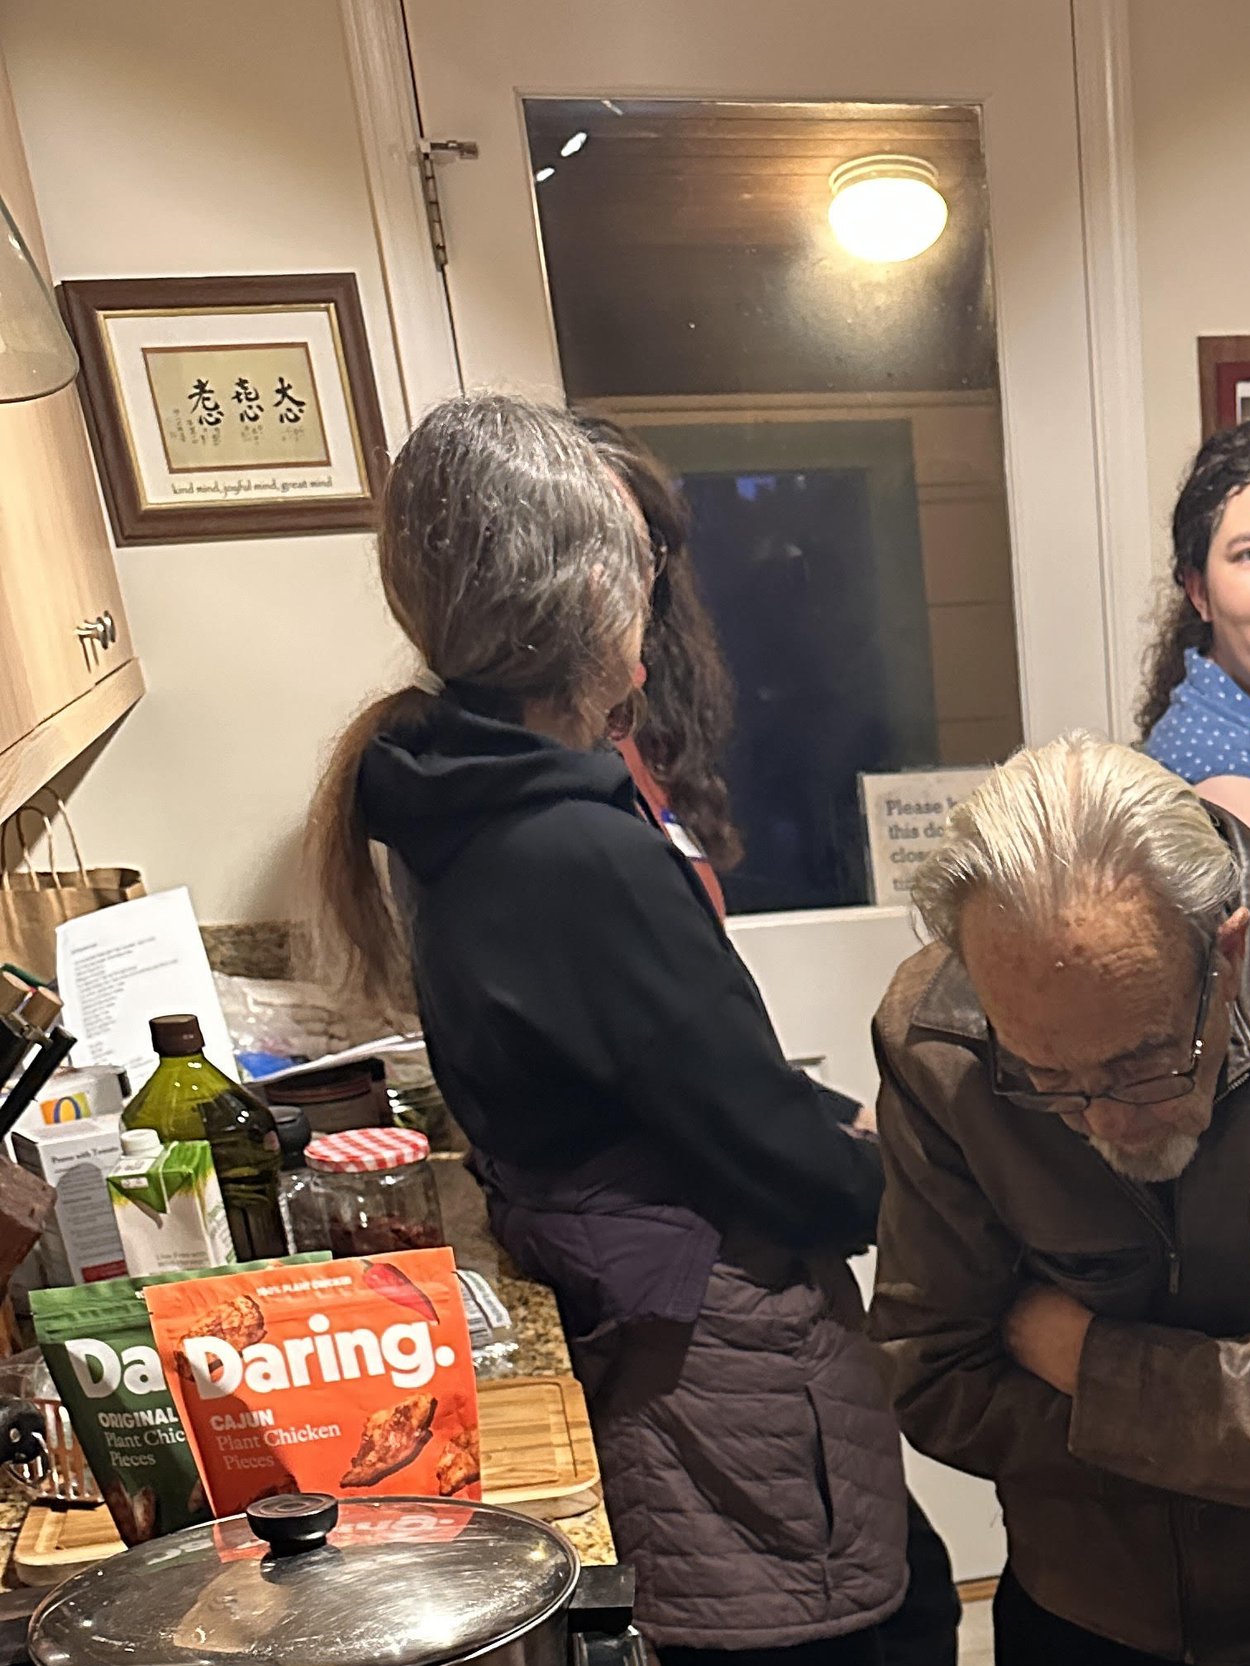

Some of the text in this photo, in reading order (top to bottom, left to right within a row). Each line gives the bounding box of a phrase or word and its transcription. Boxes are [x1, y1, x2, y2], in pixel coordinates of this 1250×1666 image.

[281, 480, 307, 493] great
[310, 475, 333, 488] mind
[886, 799, 943, 816] Please
[888, 821, 944, 839] this do
[184, 1313, 455, 1400] Daring.
[98, 1407, 179, 1429] ORIGINAL
[210, 1408, 275, 1432] CAJUN
[104, 1426, 186, 1449] Plant Chic
[215, 1423, 342, 1452] Plant Chicken
[110, 1450, 157, 1468] Pieces
[222, 1453, 275, 1471] Pieces
